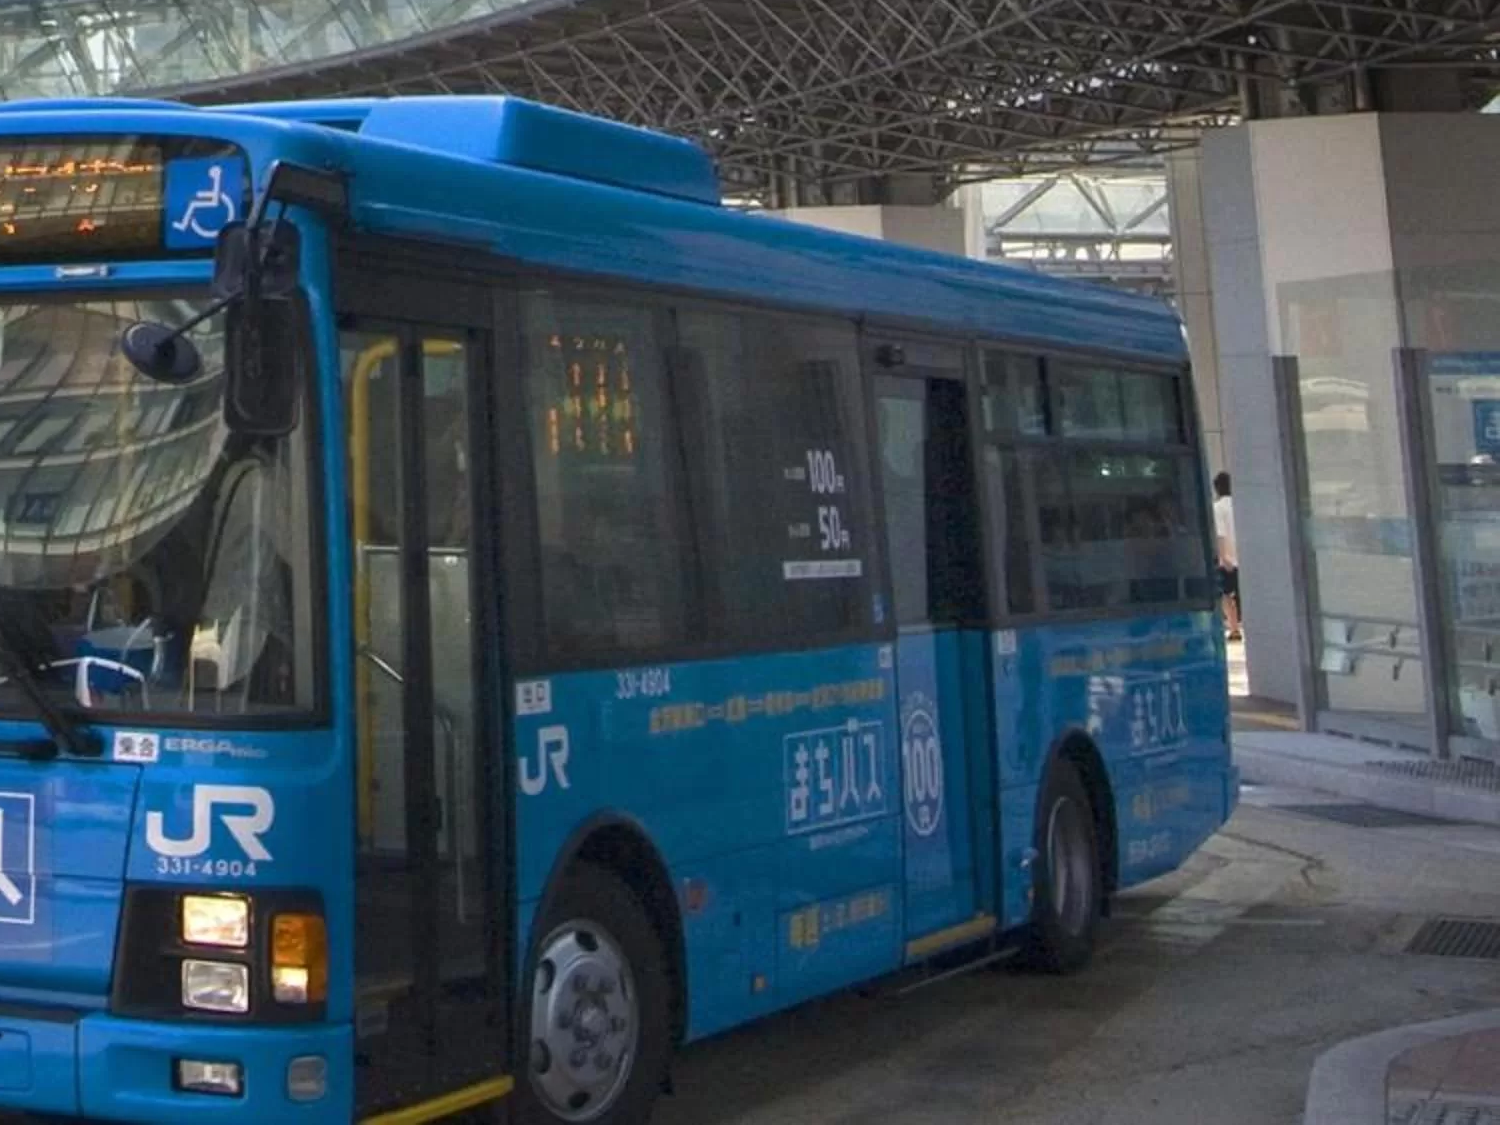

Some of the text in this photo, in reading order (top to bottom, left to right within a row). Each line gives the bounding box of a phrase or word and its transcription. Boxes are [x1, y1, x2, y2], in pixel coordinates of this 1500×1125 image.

[518, 725, 571, 795] JR
[790, 717, 882, 821] まちバス
[145, 784, 275, 862] JR
[156, 858, 257, 877] 331-4904
